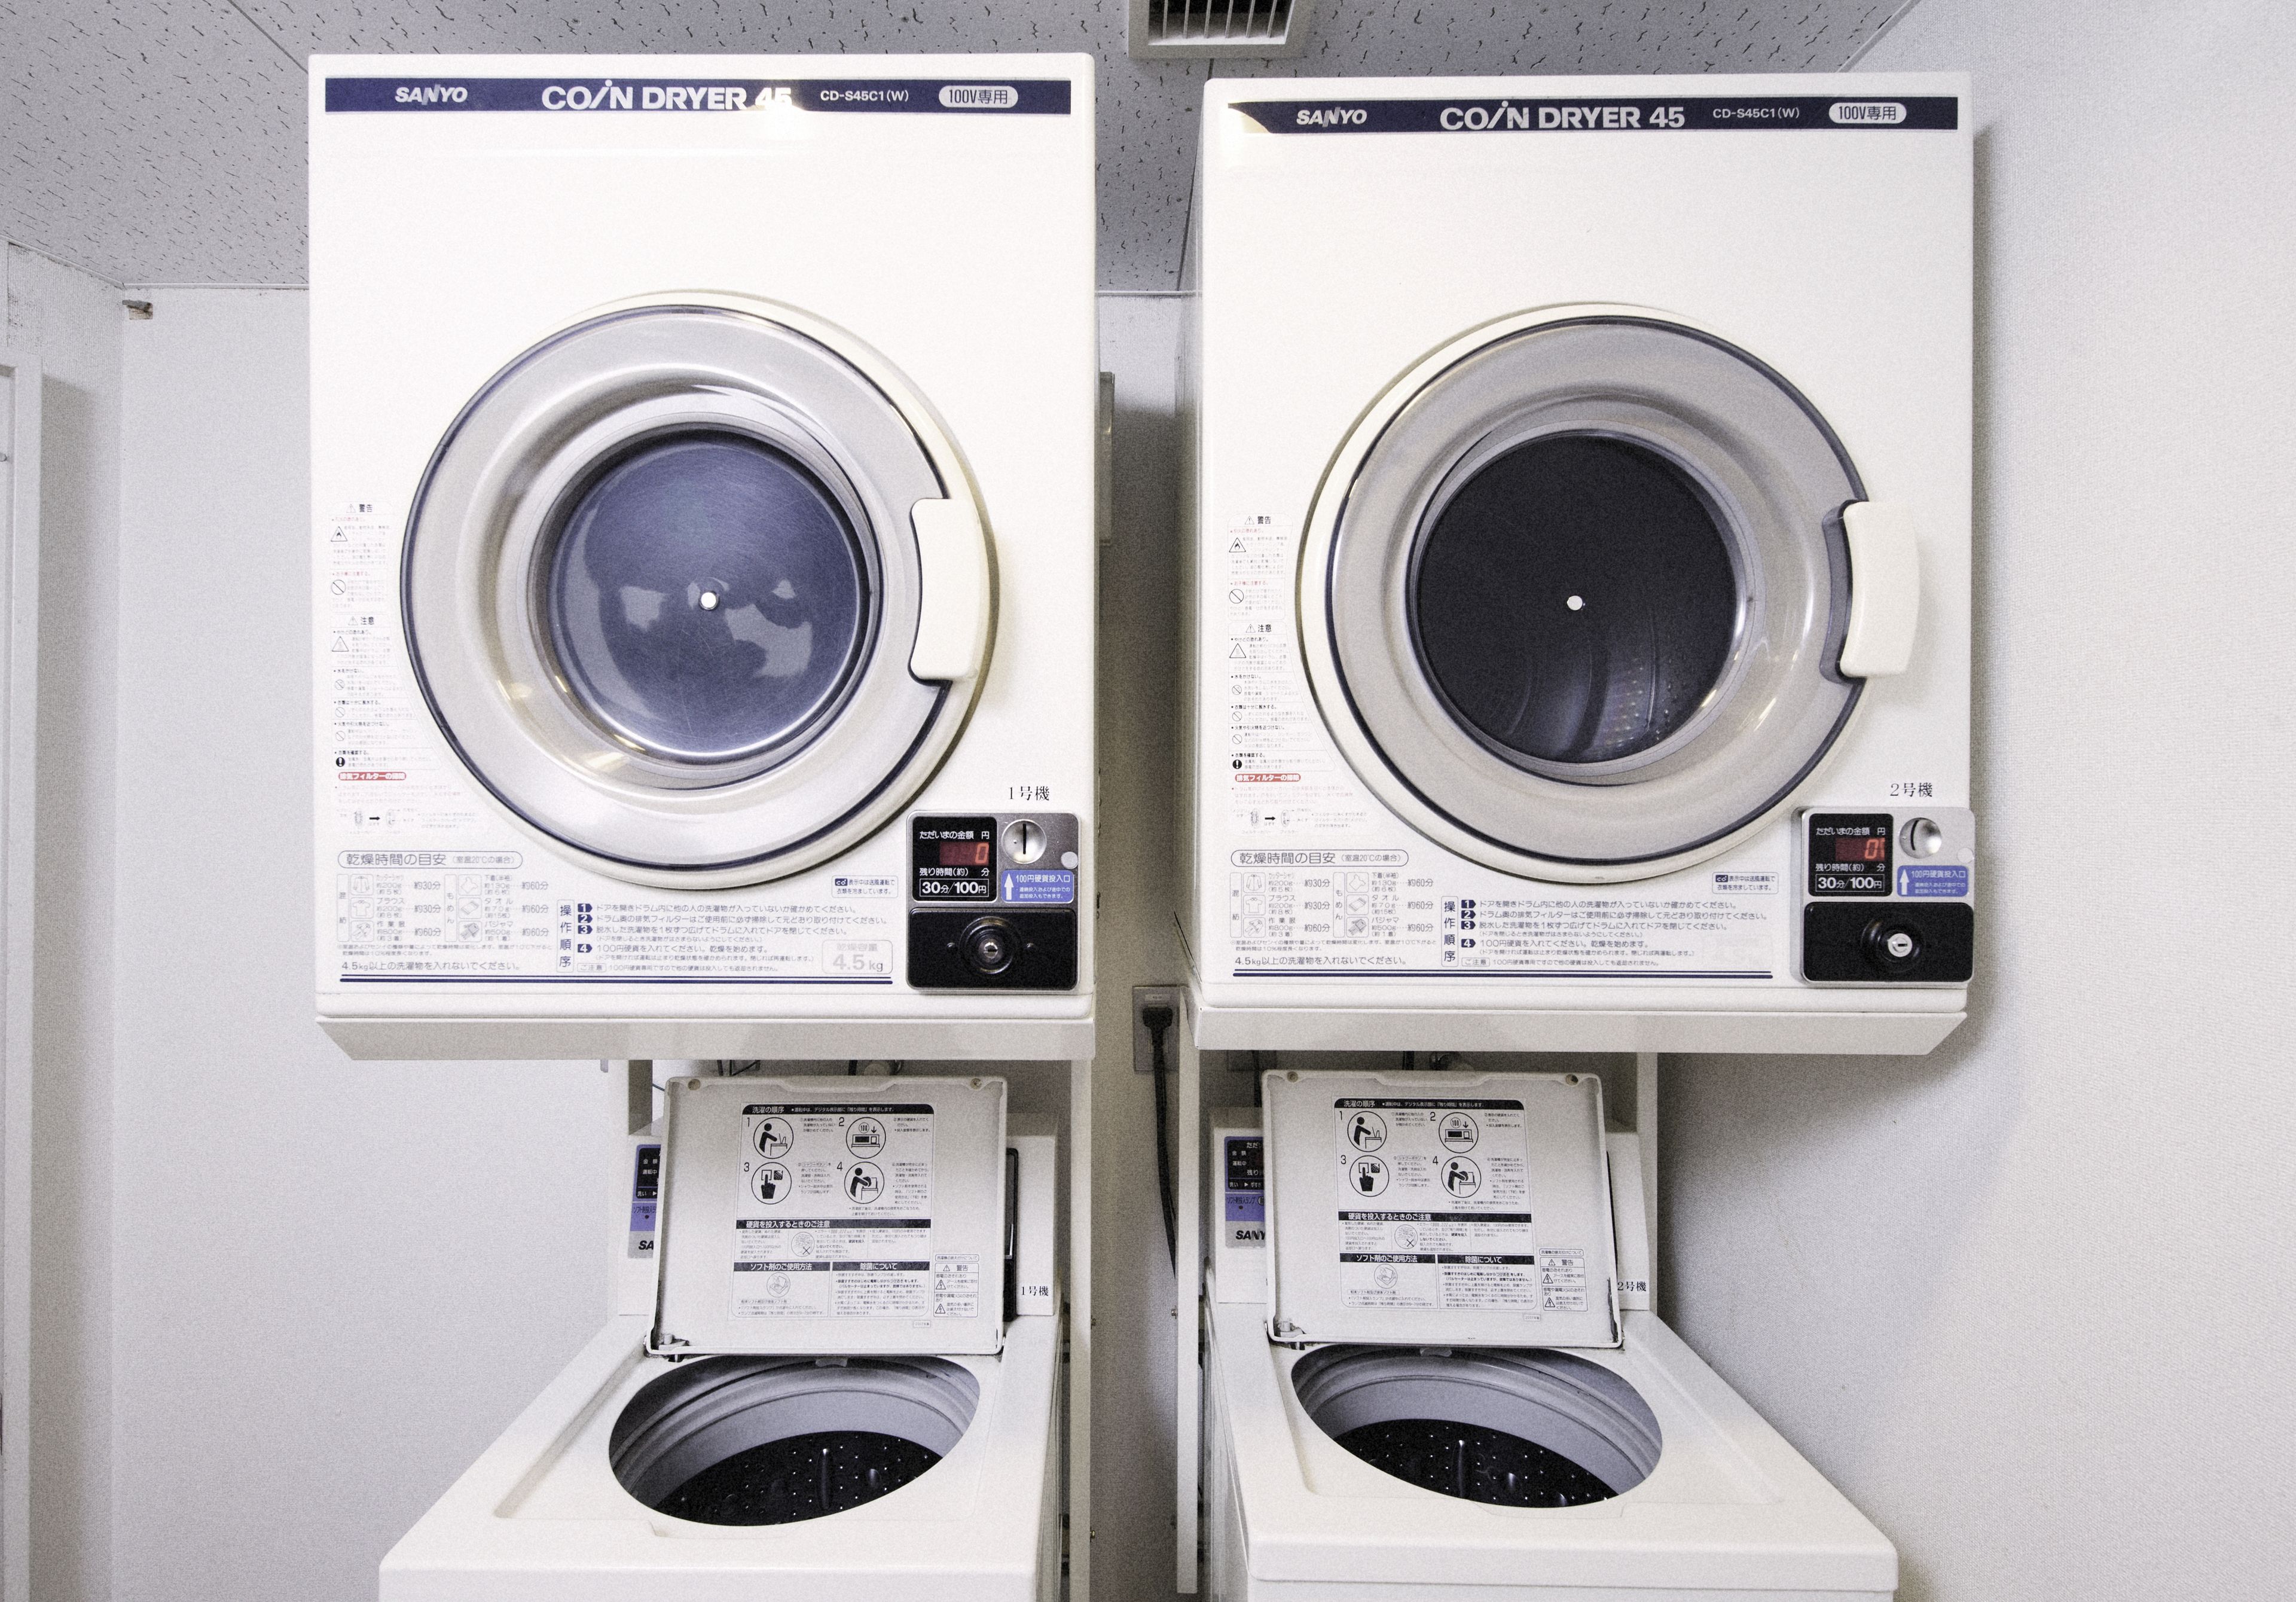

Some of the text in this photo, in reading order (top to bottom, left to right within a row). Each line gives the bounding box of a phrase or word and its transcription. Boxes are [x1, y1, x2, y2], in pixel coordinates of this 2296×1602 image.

[395, 84, 468, 105] SANYO
[542, 79, 793, 110] COIN DRYER 45
[820, 89, 909, 103] CD-S45C1(W)
[948, 89, 1009, 105] 100V専用
[1296, 106, 1367, 127] SANYO
[1440, 100, 1685, 130] COIN DRYER 45
[1712, 107, 1800, 119] CD-S45C1(W)
[1838, 105, 1897, 120] 100V専用
[1257, 516, 1271, 524] 警告
[1257, 624, 1272, 633] 注意
[1009, 786, 1051, 801] 1号機
[1889, 782, 1932, 797] 2号機
[919, 831, 974, 840] ただいまの金額
[976, 843, 990, 863] 0
[1239, 852, 1336, 864] 乾燥時間の目安
[346, 853, 447, 866] 乾燥時間の目安
[919, 868, 990, 877] 残り時間（約） 分
[1815, 863, 1886, 872] 残り時間（約） 分
[1016, 874, 1070, 883] 100円硬貨投入口
[1304, 879, 1330, 887] 約30分
[1407, 879, 1433, 887] 約60分
[1818, 877, 1882, 889] 30分/100円
[414, 881, 441, 890] 約30分
[522, 881, 548, 890] 約60分
[922, 881, 987, 894] 30分/100円
[414, 905, 441, 913] 約30分
[522, 905, 549, 913] 約60分
[581, 904, 587, 912] 1
[580, 914, 588, 923] 2
[1464, 910, 1472, 919] 2
[1304, 924, 1330, 932] 約60分
[1407, 924, 1433, 932] 約60分
[1464, 921, 1472, 929] 3
[414, 928, 441, 936] 約60分
[523, 928, 549, 936] 約60分
[560, 904, 572, 968] 操作順序
[1444, 901, 1455, 962] 操作順序
[341, 961, 519, 971] 4.5kg以上の洗濯物を入れないでください。
[1235, 956, 1406, 966] 4.5kg以上の洗濯物を入れないでください。
[1339, 1110, 1342, 1120] 1
[1430, 1111, 1436, 1121] 2
[747, 1117, 750, 1127] 1
[838, 1116, 845, 1127] 2
[1341, 1155, 1347, 1164] 3
[1433, 1156, 1439, 1165] 4
[744, 1162, 750, 1172] 3
[836, 1161, 843, 1171] 4
[1348, 1213, 1431, 1221] 硬貨を投入するときのご注意
[1021, 1286, 1049, 1296] 1号機
[1617, 1281, 1646, 1292] 2号機
